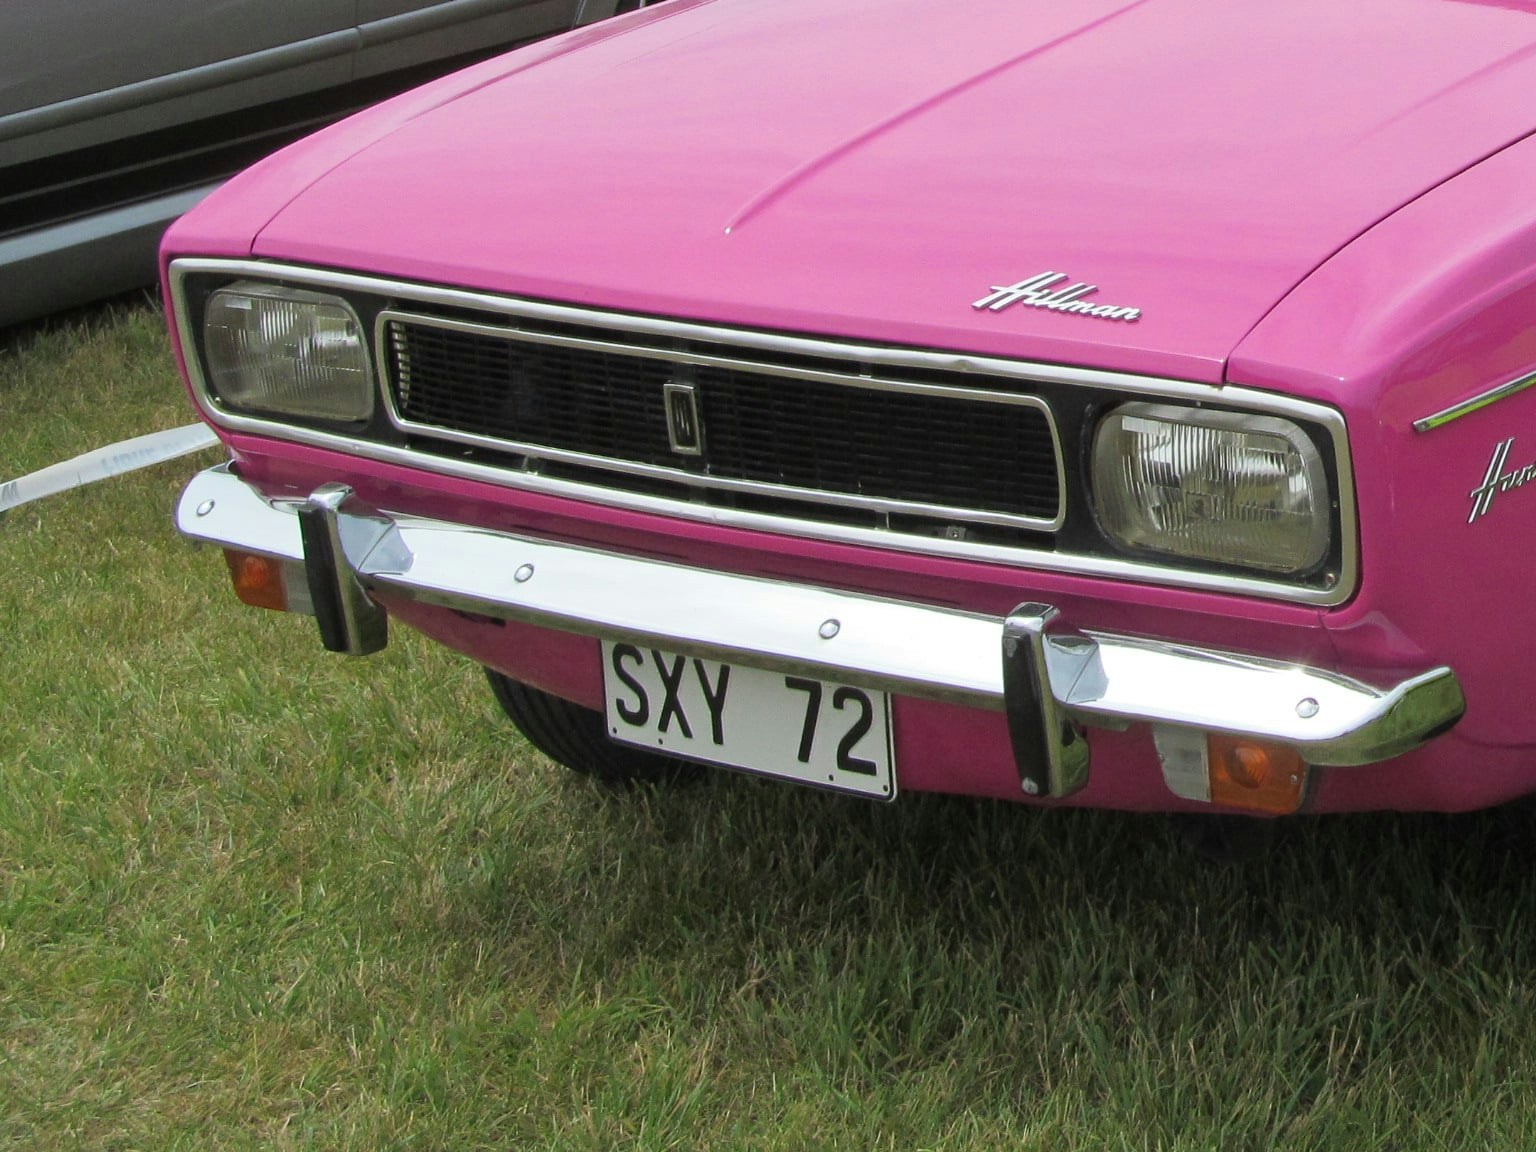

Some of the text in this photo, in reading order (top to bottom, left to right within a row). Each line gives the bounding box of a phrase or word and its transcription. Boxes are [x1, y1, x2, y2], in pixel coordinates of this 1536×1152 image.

[970, 270, 1143, 324] Hillman
[612, 642, 878, 777] SXY 72
